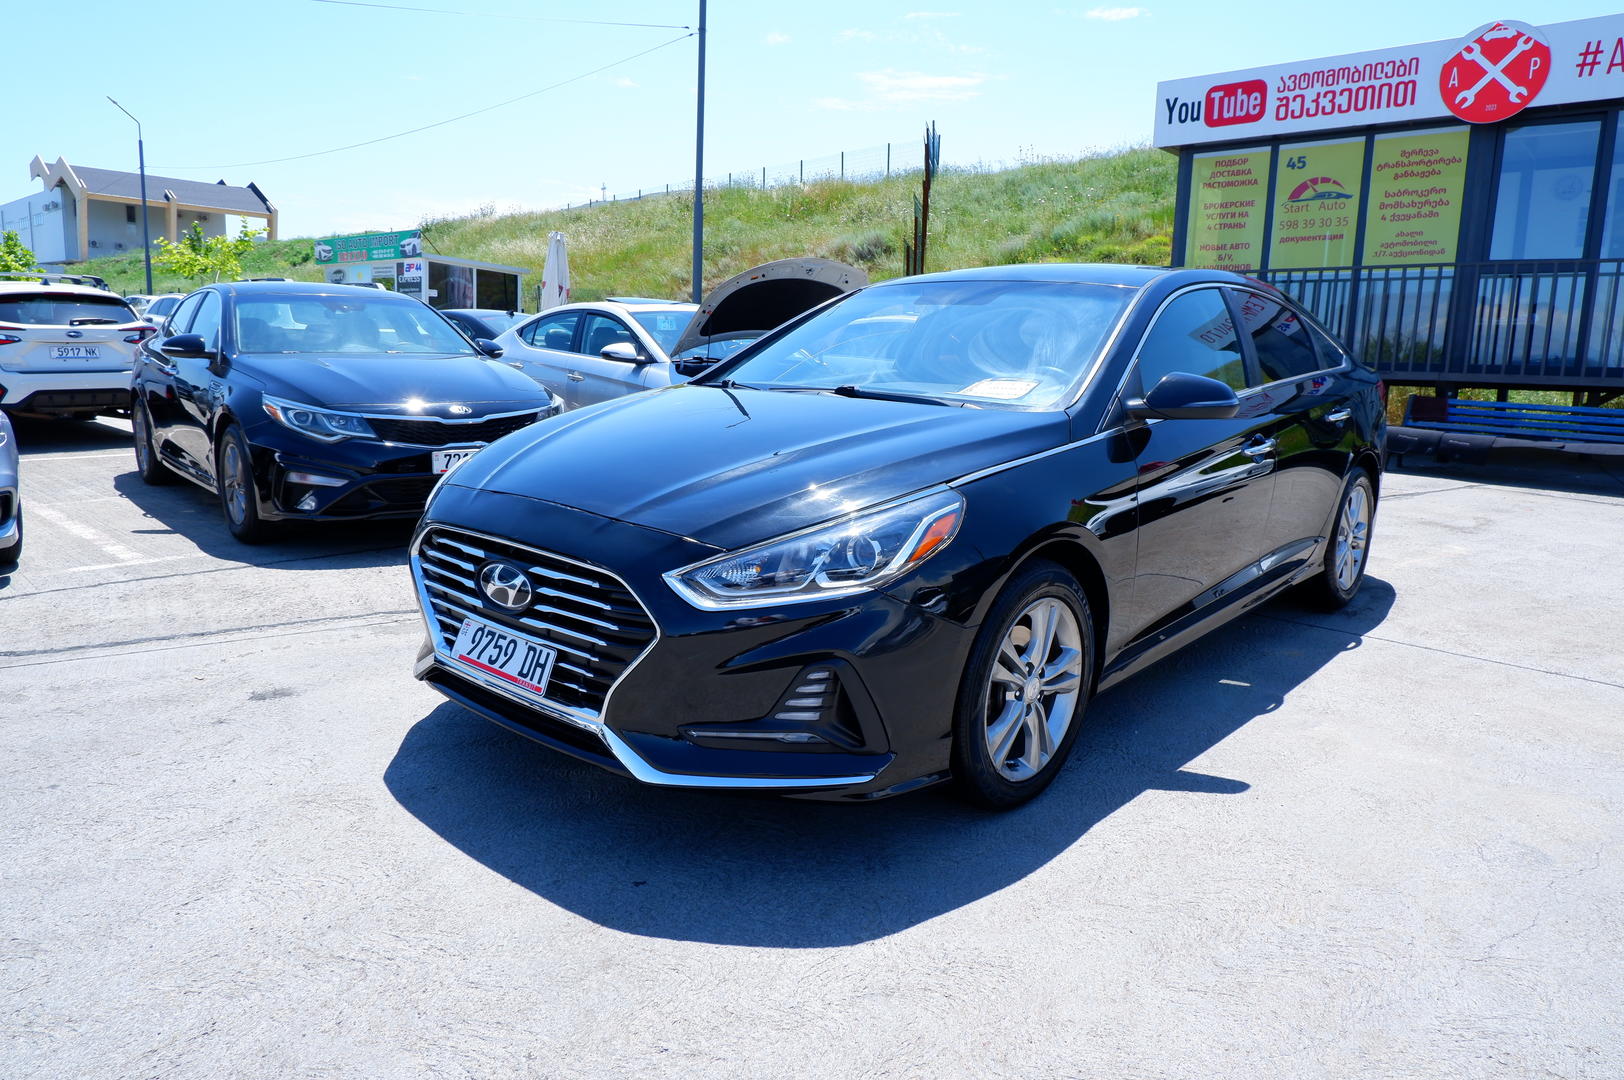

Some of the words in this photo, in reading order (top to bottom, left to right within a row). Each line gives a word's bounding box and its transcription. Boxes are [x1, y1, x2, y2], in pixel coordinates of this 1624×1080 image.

[1529, 57, 1541, 79] P
[1277, 57, 1419, 93] ავტომობილები
[1448, 67, 1459, 88] A
[1275, 80, 1417, 121] შეკვეთით
[1215, 158, 1249, 168] ПОДБОР
[1286, 156, 1307, 170] 45
[1209, 168, 1253, 180] ДОСТАВКА
[1203, 178, 1259, 189] РАСТОМОЖКА
[1203, 200, 1256, 210] БРОКЕРСКИЕ
[1283, 203, 1310, 214] Start
[1318, 201, 1346, 212] Auto
[1206, 211, 1236, 221] УСЛУГИ
[1238, 211, 1249, 219] НА
[1214, 222, 1247, 231] СТРАНЫ
[1280, 220, 1299, 230] 598
[1303, 219, 1316, 229] 39
[1319, 217, 1332, 228] 30
[1335, 216, 1349, 227] 35
[1200, 243, 1228, 252] НОВЫЕ
[1229, 242, 1250, 251] АВТО
[57, 348, 80, 357] 5917
[85, 347, 97, 357] NK
[444, 452, 469, 469] 72
[466, 624, 518, 670] 9759
[517, 643, 550, 685] DH
